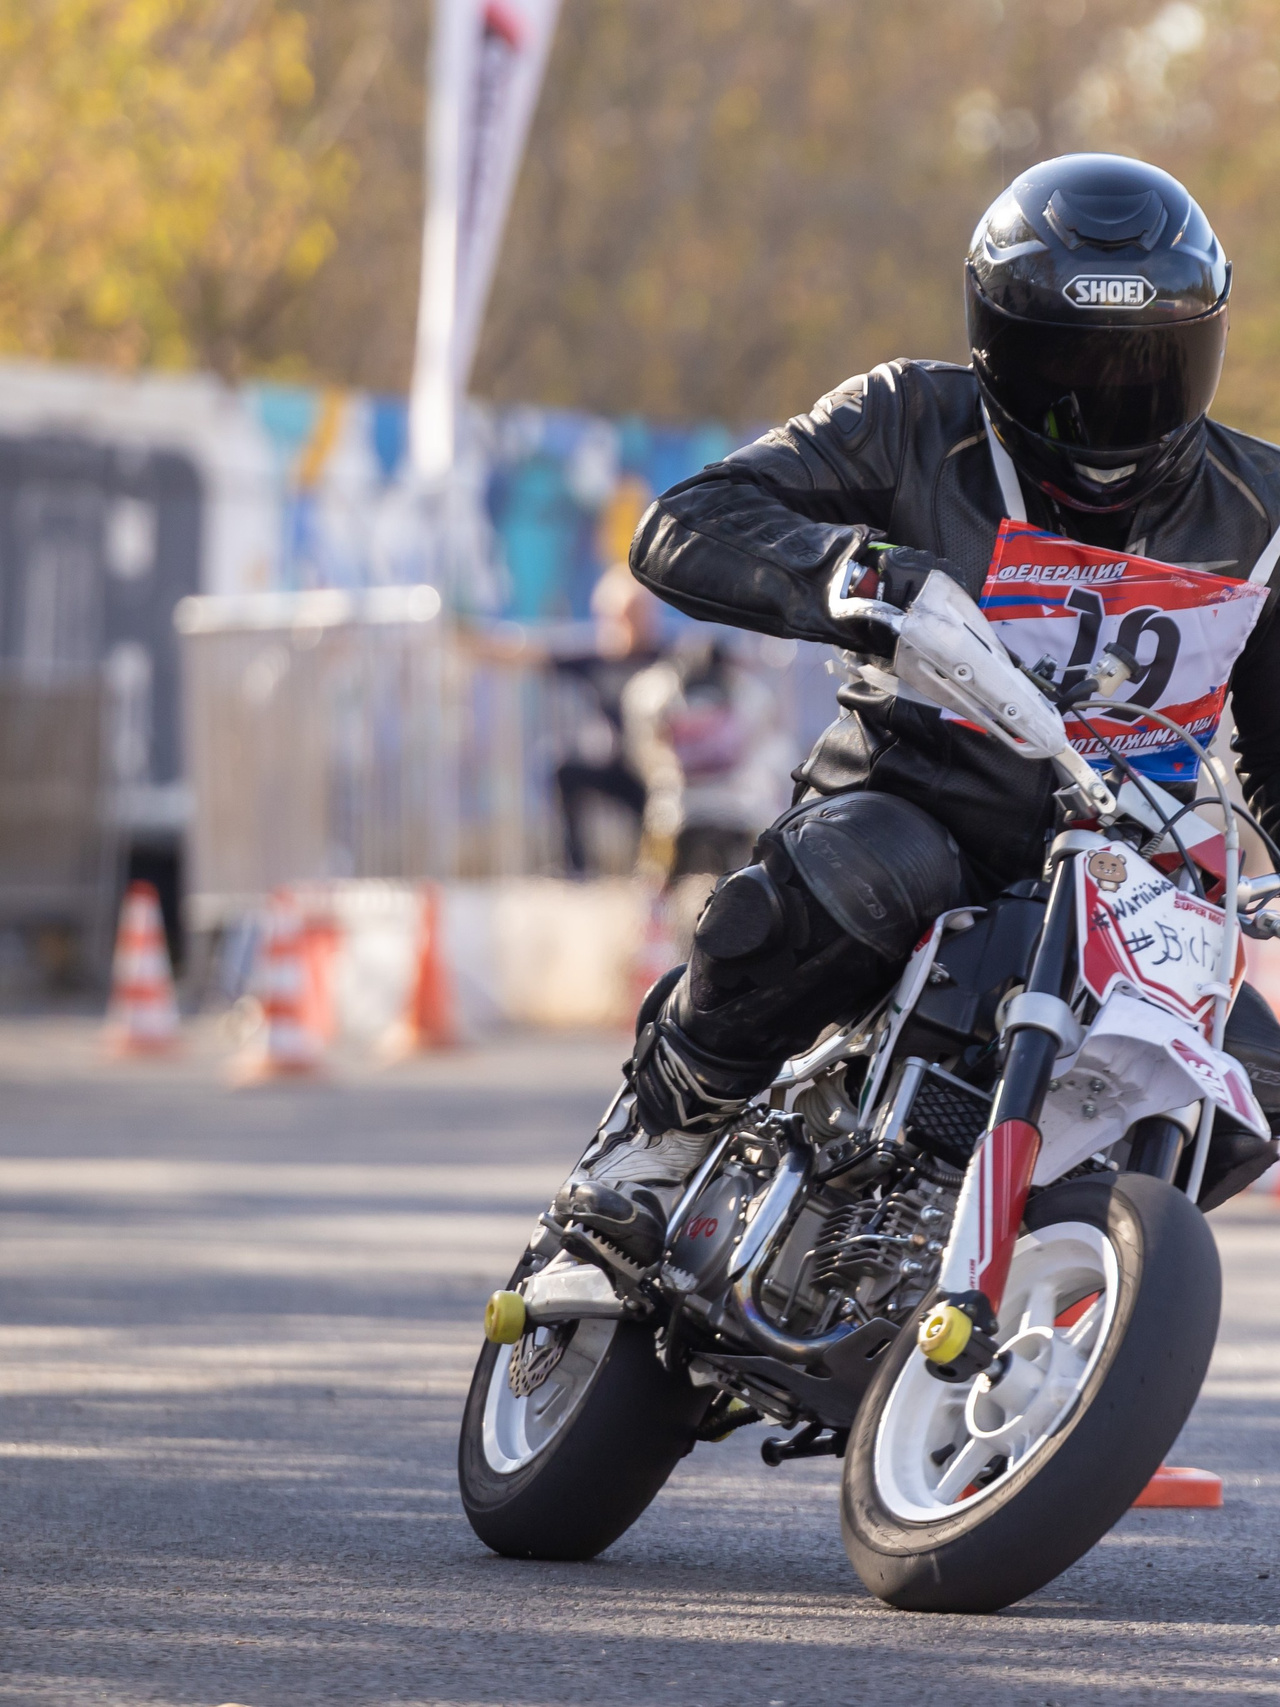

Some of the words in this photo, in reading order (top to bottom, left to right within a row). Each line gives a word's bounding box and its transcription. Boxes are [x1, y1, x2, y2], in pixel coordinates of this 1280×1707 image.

[1075, 280, 1144, 303] SHOEI
[998, 561, 1128, 583] ФЕДЕРАЦИЯ
[1174, 900, 1206, 919] SUPER
